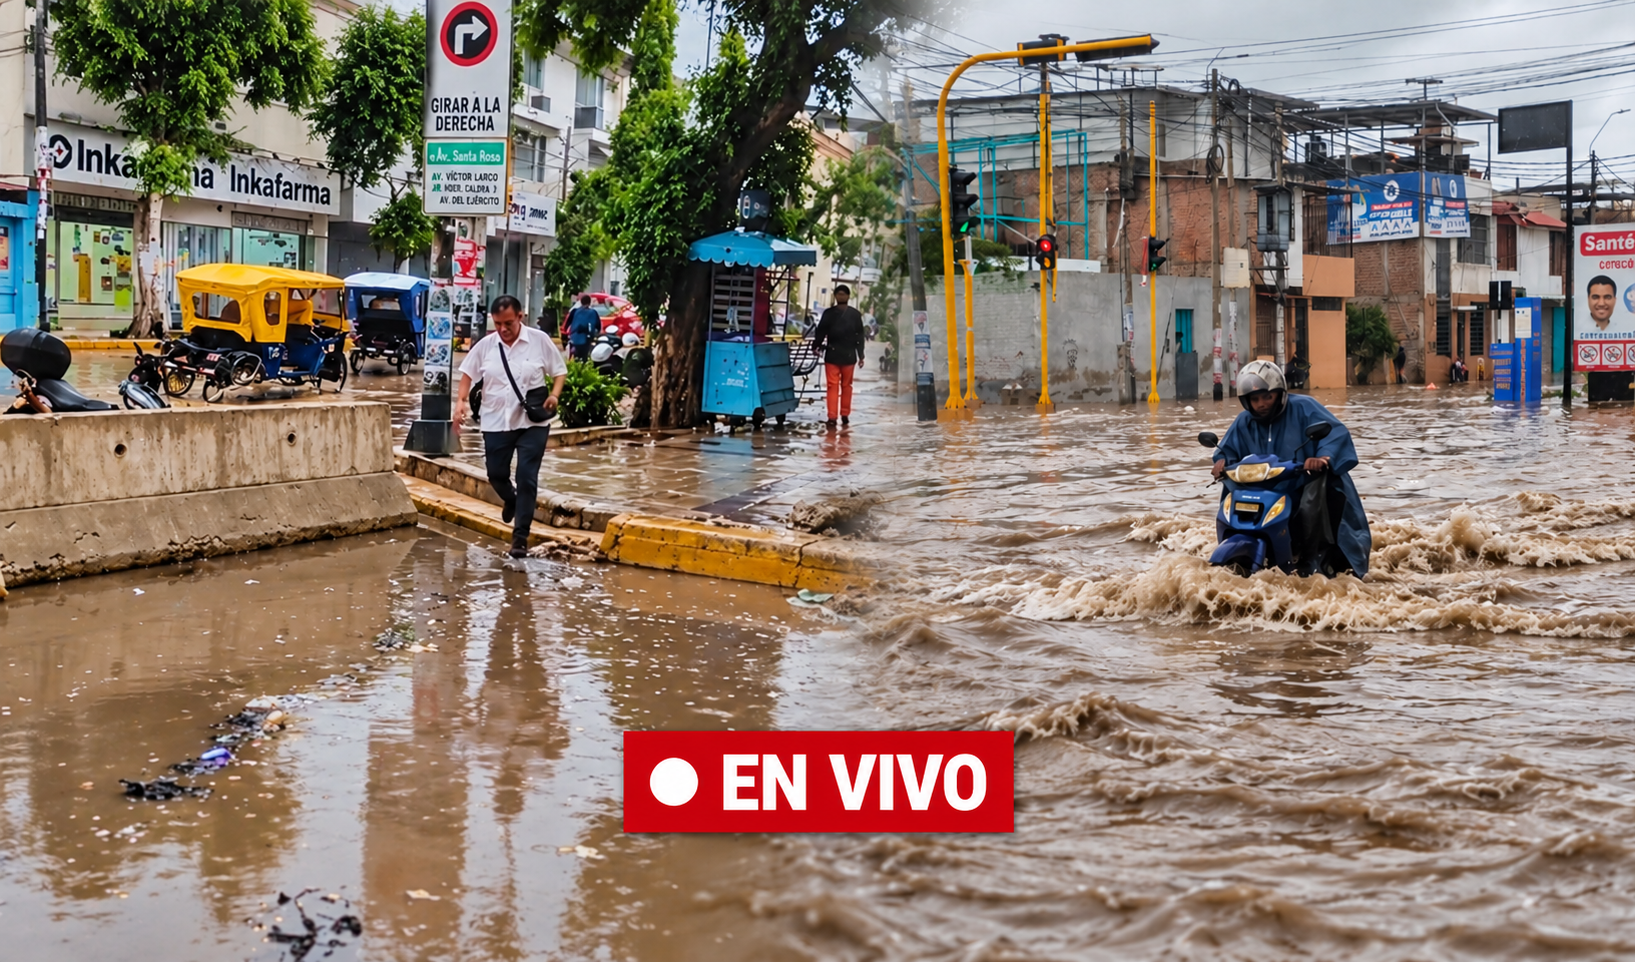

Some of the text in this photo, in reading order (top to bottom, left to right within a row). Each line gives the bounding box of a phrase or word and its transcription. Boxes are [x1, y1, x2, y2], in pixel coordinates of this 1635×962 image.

[431, 97, 501, 113] GIRAR A LA
[436, 115, 495, 131] DERECHA
[446, 170, 472, 182] VÍCTOR
[475, 172, 498, 182] LARCO
[231, 164, 330, 206] Inkafarma
[452, 196, 464, 205] DEL
[1585, 233, 1635, 252] Santé
